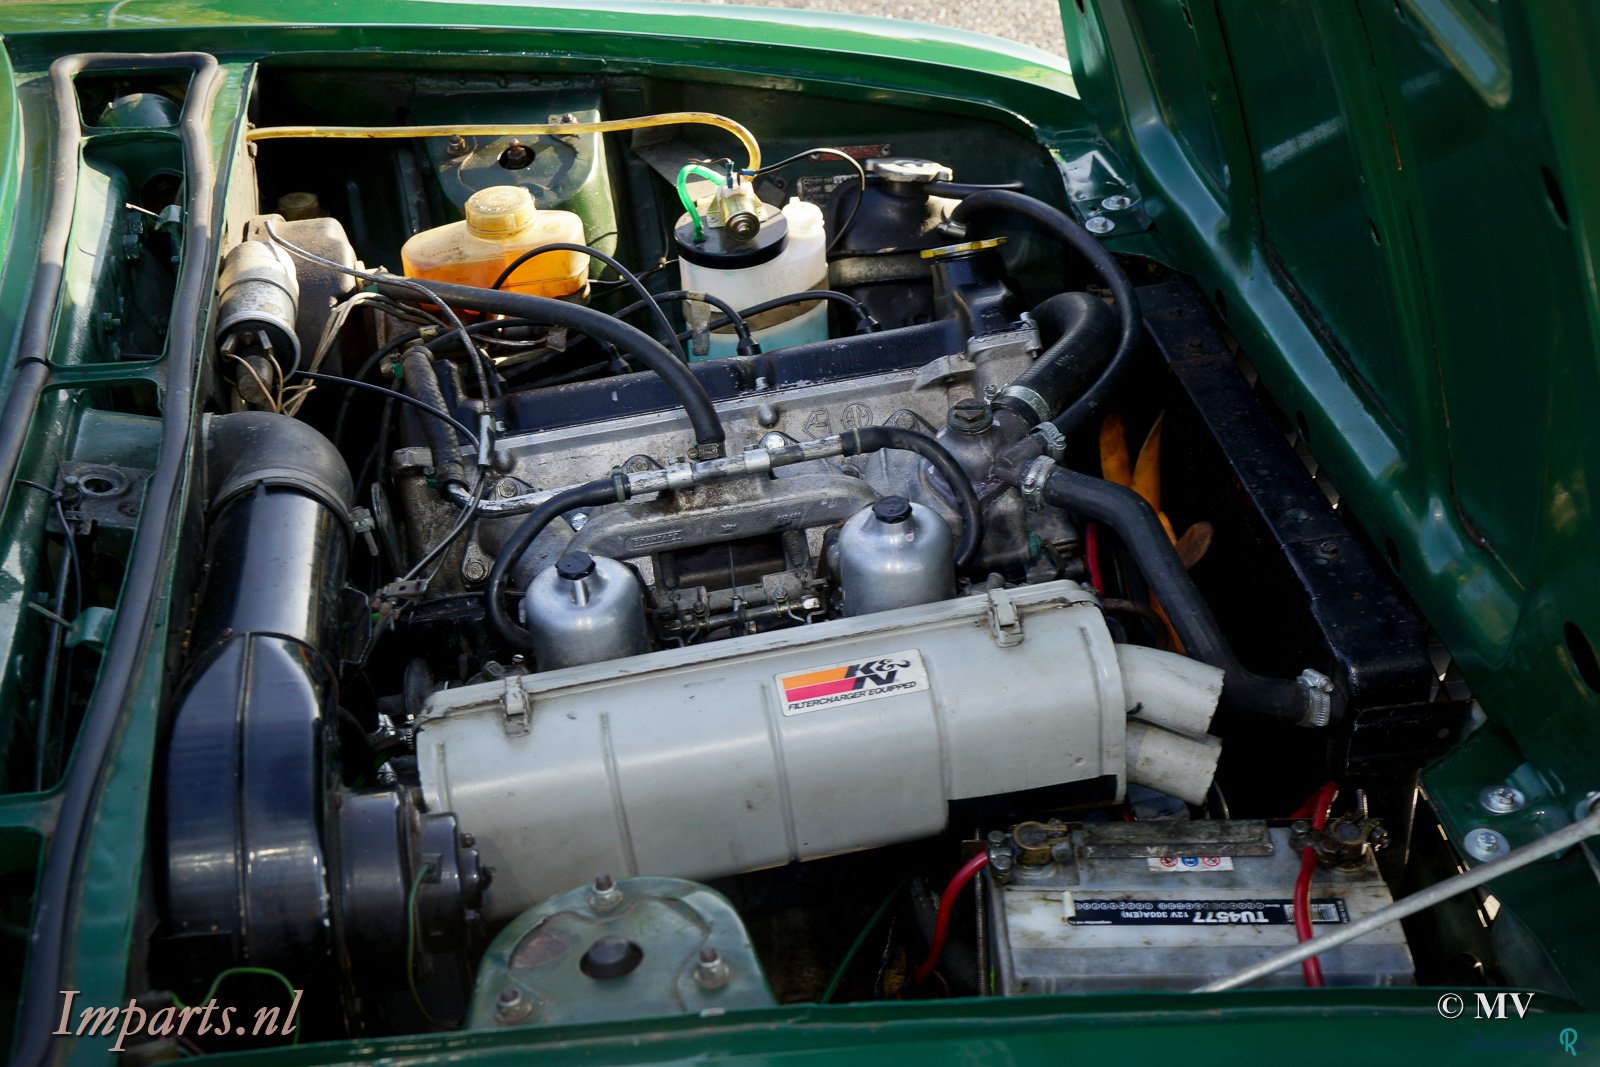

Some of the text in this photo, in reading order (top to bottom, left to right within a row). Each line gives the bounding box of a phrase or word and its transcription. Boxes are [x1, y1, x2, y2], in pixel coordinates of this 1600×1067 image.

[788, 681, 917, 711] FILTERCHARGER EQUIPPED
[1192, 911, 1269, 923] TU4577
